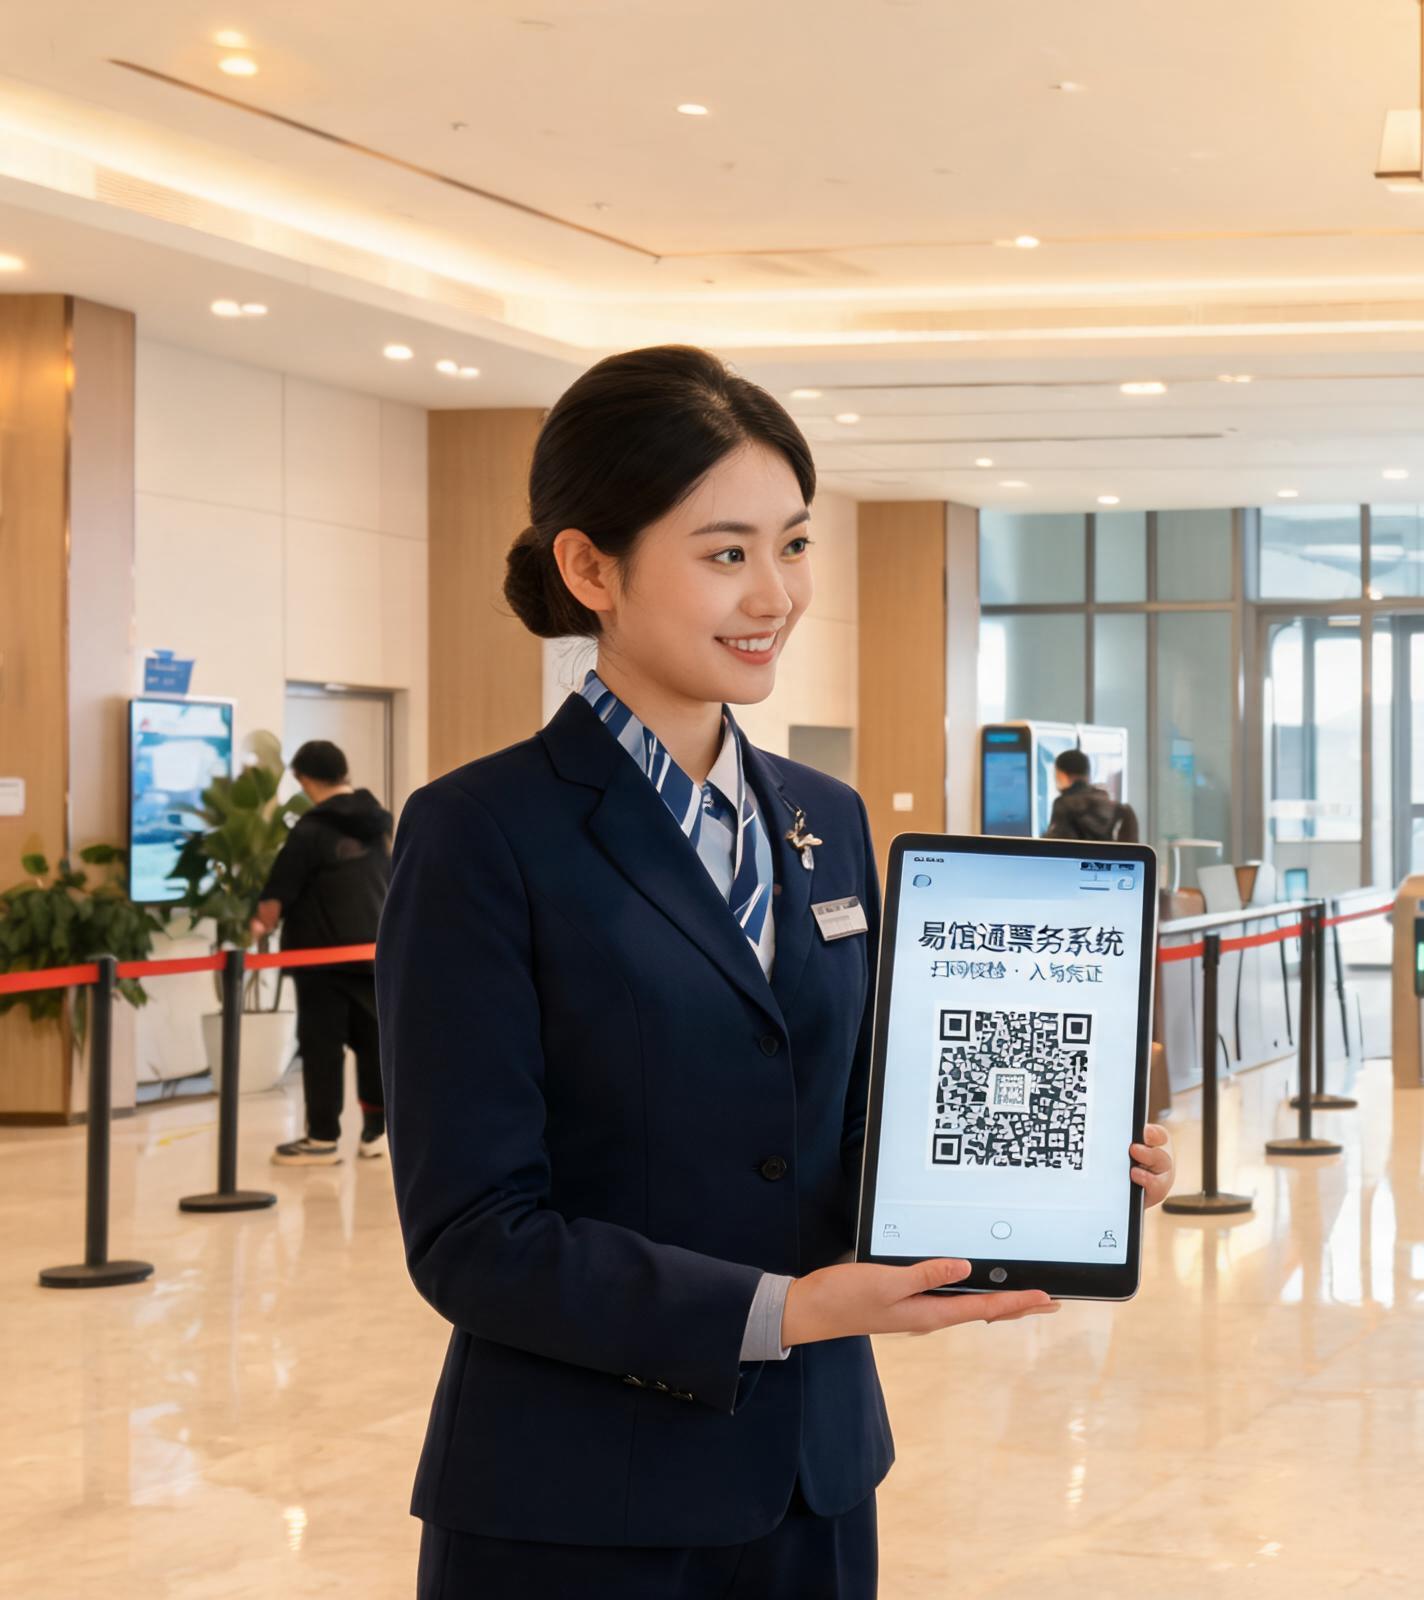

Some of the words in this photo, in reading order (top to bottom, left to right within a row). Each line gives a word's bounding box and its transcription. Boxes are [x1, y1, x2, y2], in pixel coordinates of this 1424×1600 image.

[918, 921, 1125, 957] 易馆通票务系统
